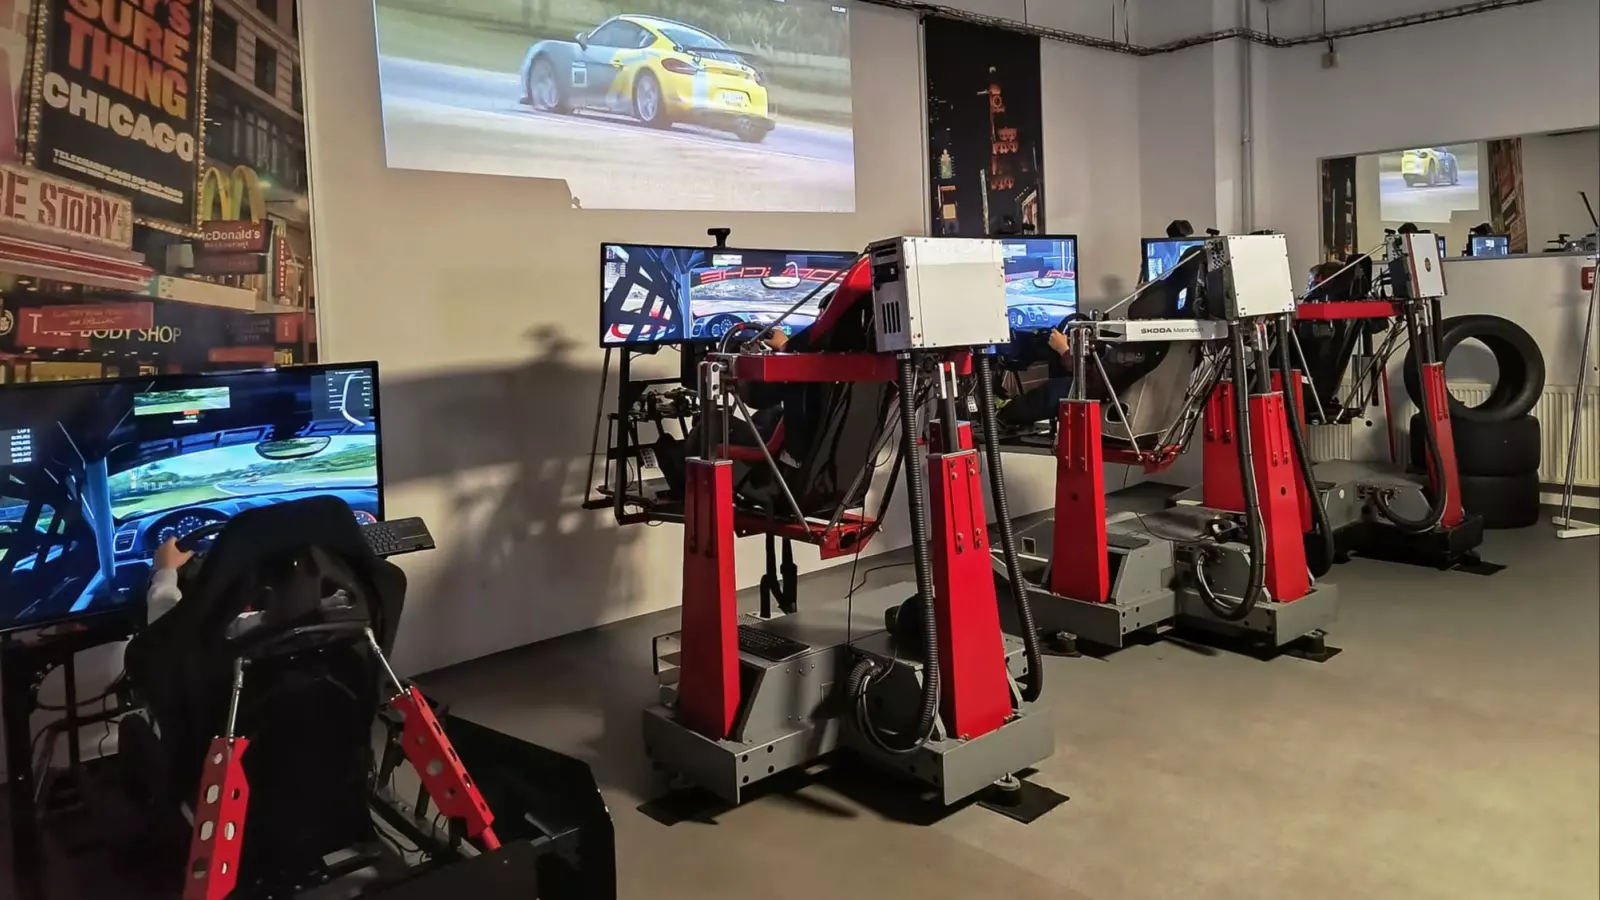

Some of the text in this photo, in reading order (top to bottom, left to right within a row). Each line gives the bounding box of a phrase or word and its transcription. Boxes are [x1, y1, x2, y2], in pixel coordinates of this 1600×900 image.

[64, 9, 188, 120] THING
[43, 72, 195, 162] CHICAGO
[0, 171, 29, 219] E
[38, 182, 120, 240] STORY
[137, 325, 182, 343] SHOP
